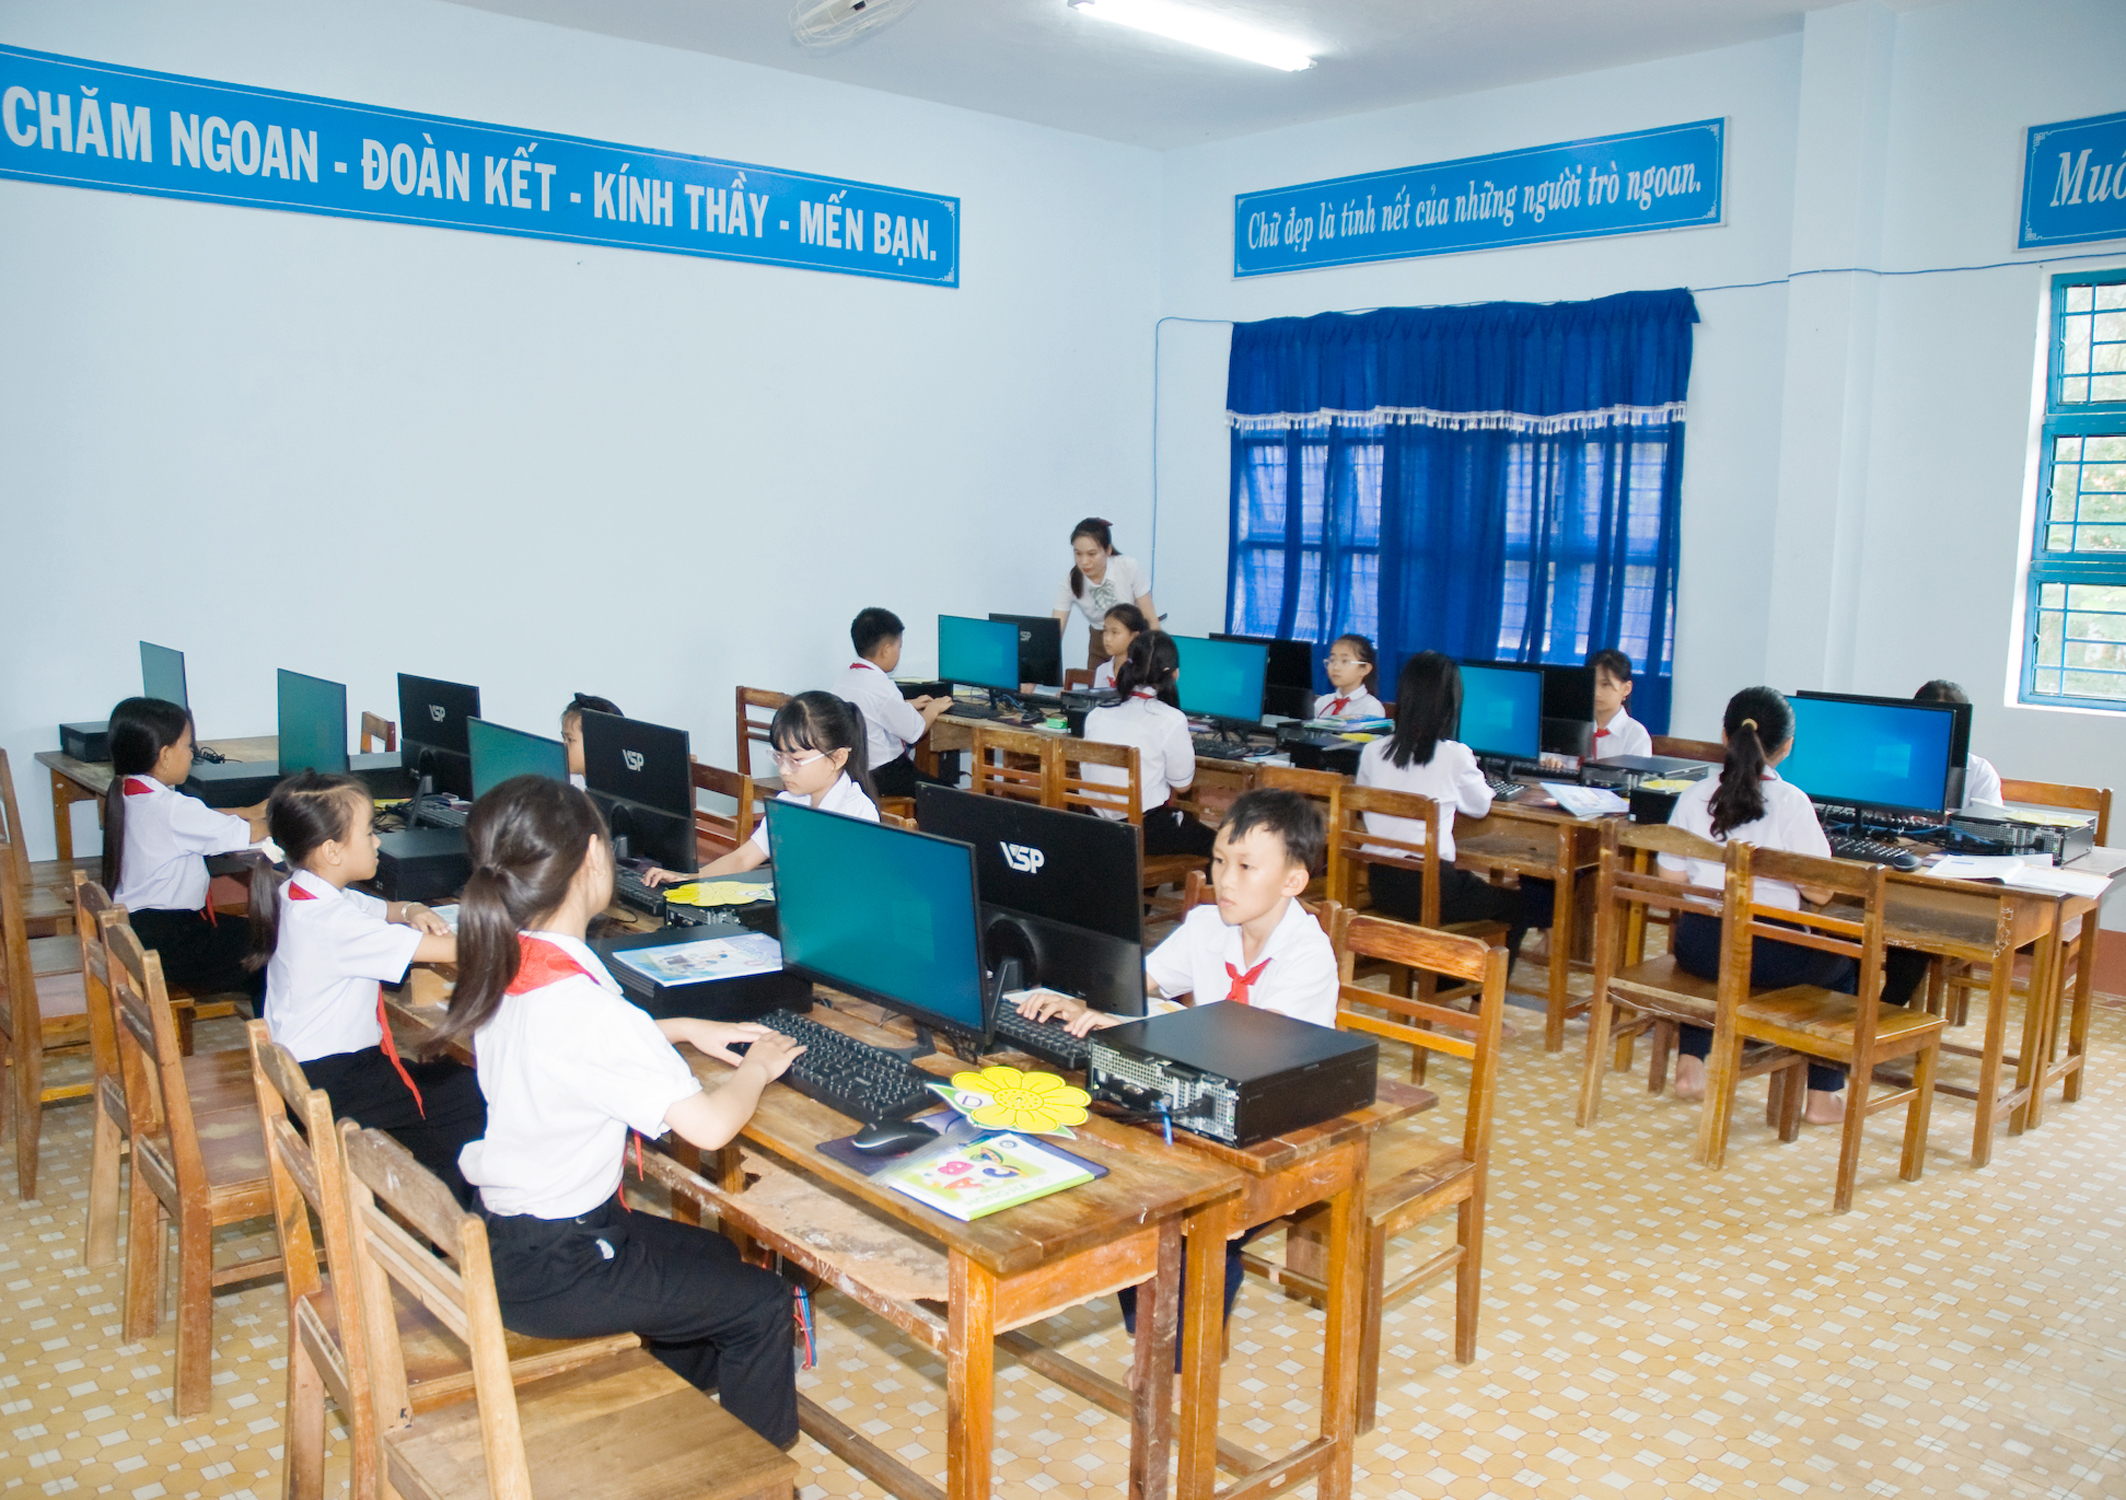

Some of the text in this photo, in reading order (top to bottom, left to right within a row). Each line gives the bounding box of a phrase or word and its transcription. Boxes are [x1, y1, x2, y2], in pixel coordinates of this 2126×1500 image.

[2, 85, 153, 163] CHĂM
[170, 111, 318, 183] NGOAN
[361, 132, 470, 202] ĐOÀN
[484, 142, 557, 212] KẾT
[593, 163, 674, 228] KÍNH
[685, 171, 770, 238] THẦY
[800, 190, 864, 252] MẾN
[873, 212, 937, 266] BẠN.
[1248, 160, 1702, 253] Chữ đẹp là tính nết của những người trò ngoan.
[428, 704, 446, 723] VSP
[622, 749, 645, 771] VSP
[999, 840, 1045, 874] VSP
